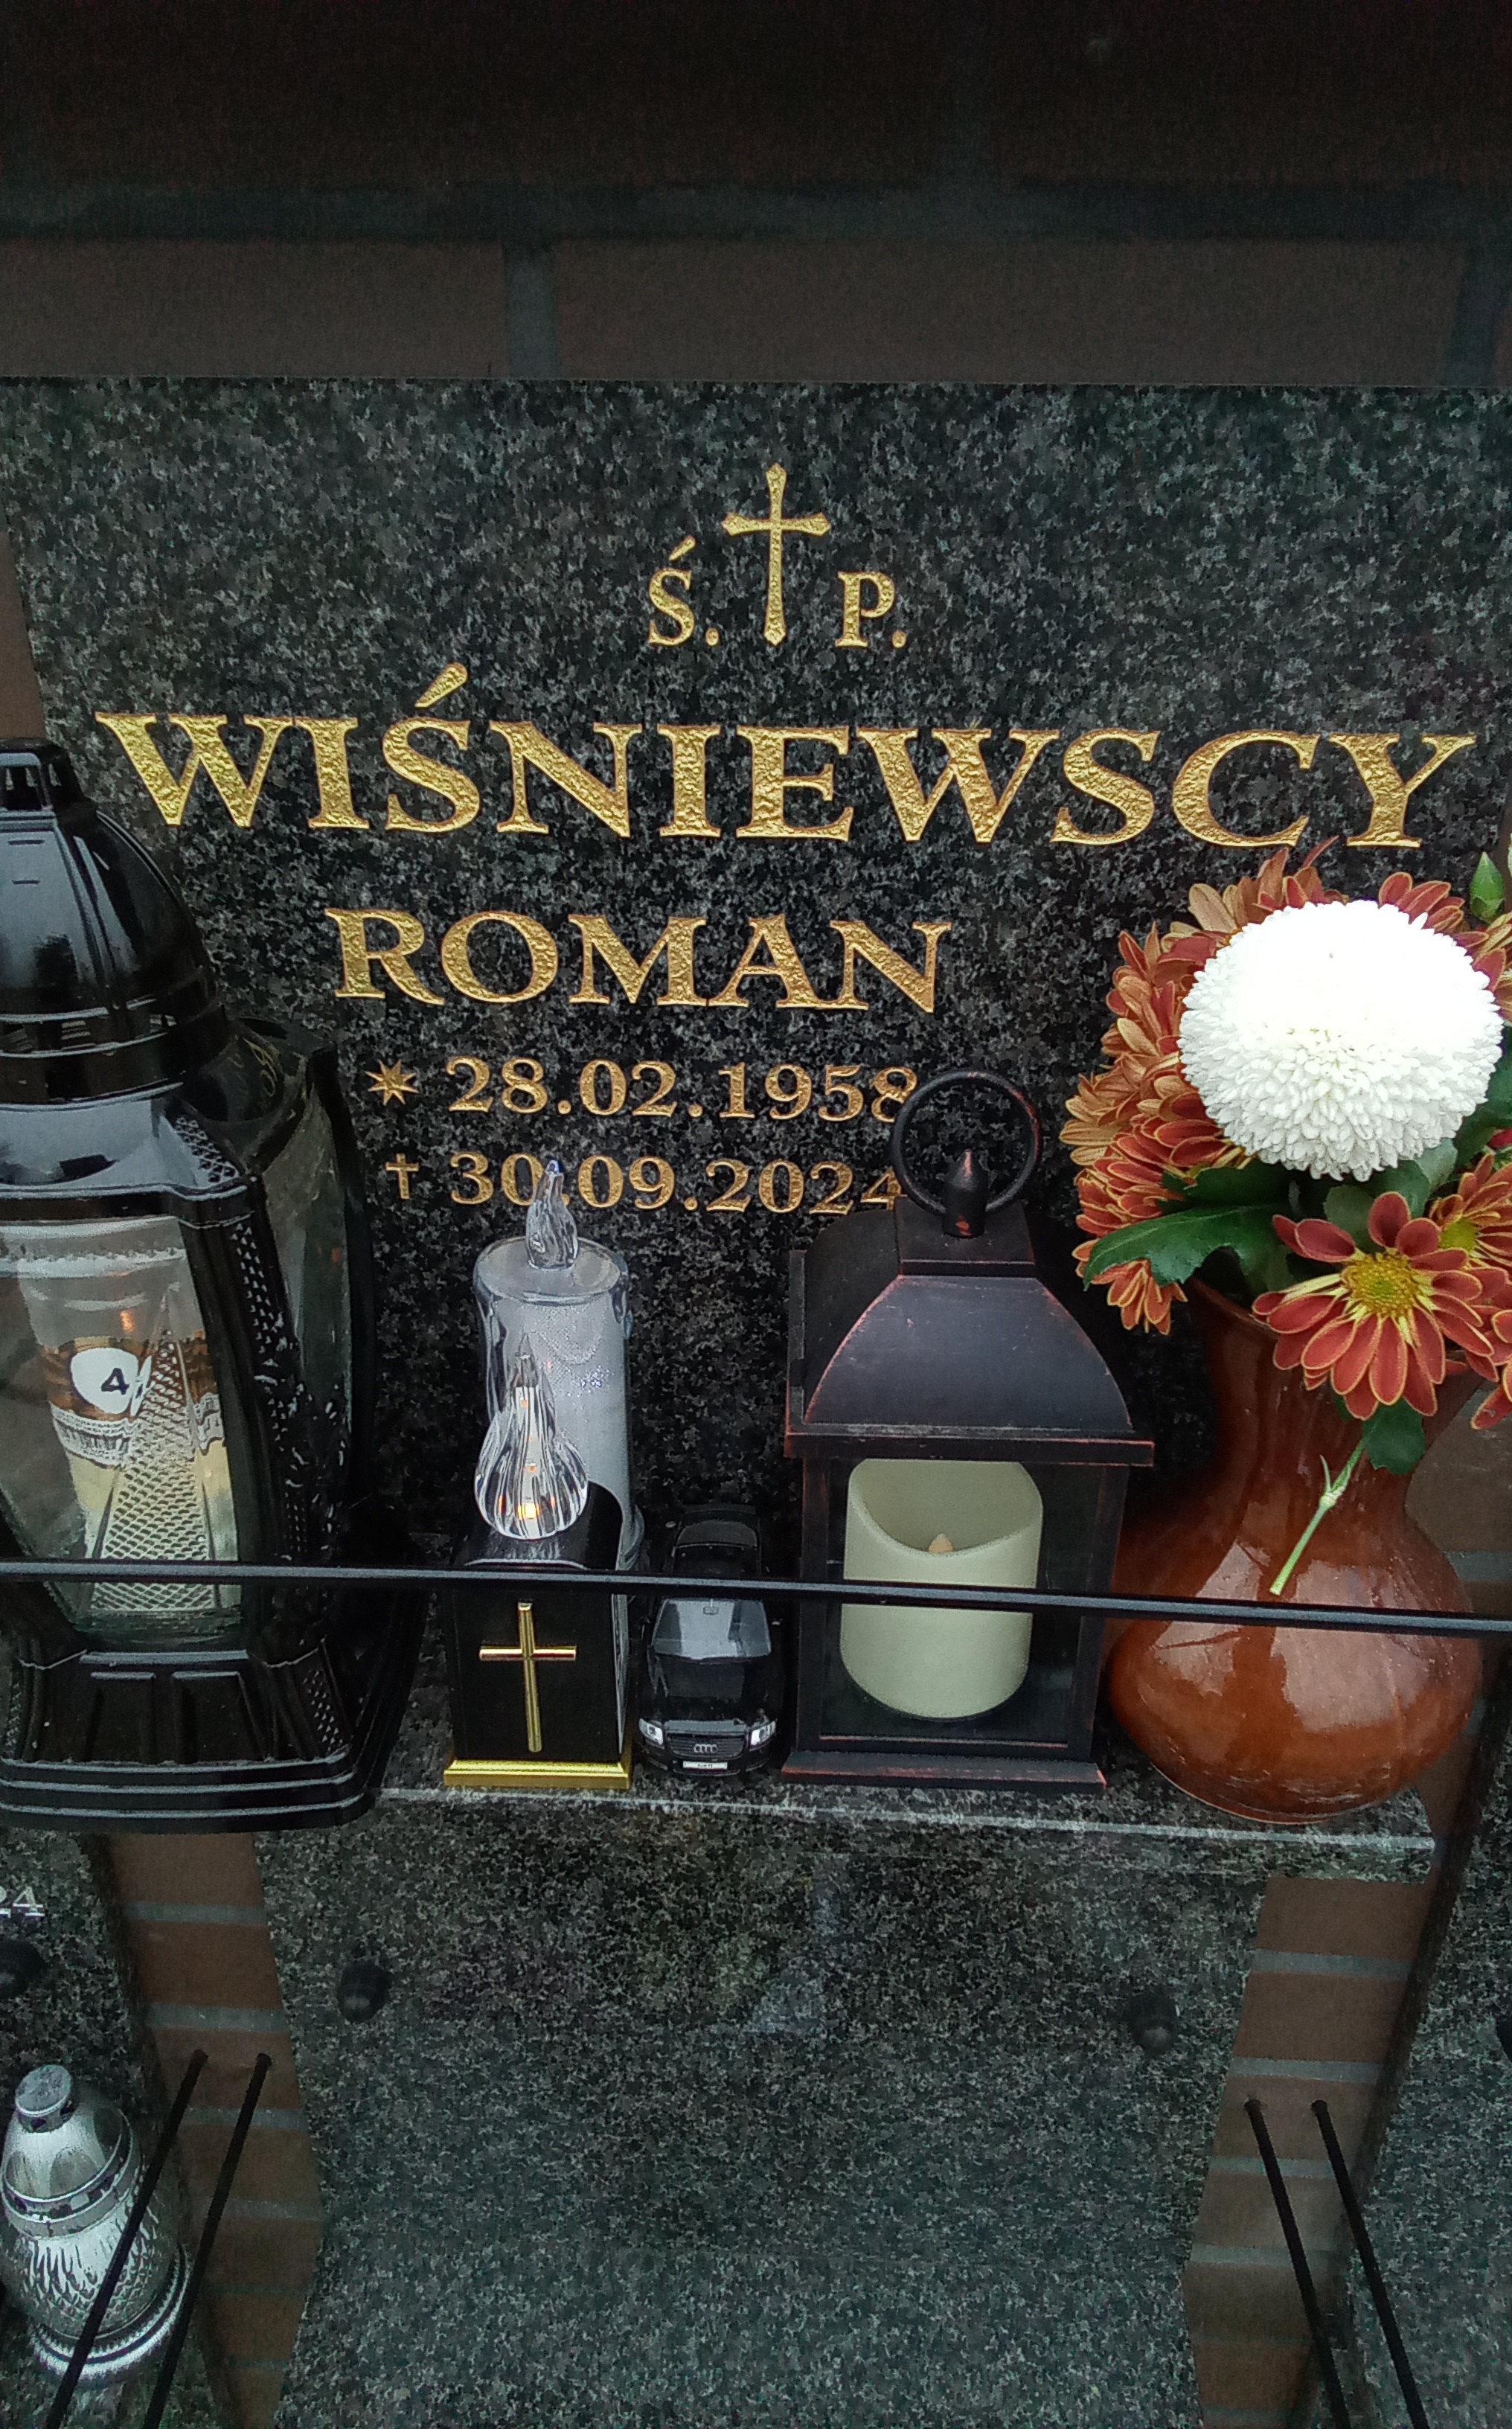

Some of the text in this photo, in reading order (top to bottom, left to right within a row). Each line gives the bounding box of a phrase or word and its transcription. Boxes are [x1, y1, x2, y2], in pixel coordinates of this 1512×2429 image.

[647, 535, 908, 648] Ś. P.
[94, 662, 1477, 848] WIŚNIEWSCY
[324, 907, 952, 1014] ROMAN
[446, 1055, 917, 1123] 28.02.1958
[450, 1151, 908, 1216] 30.09.2024
